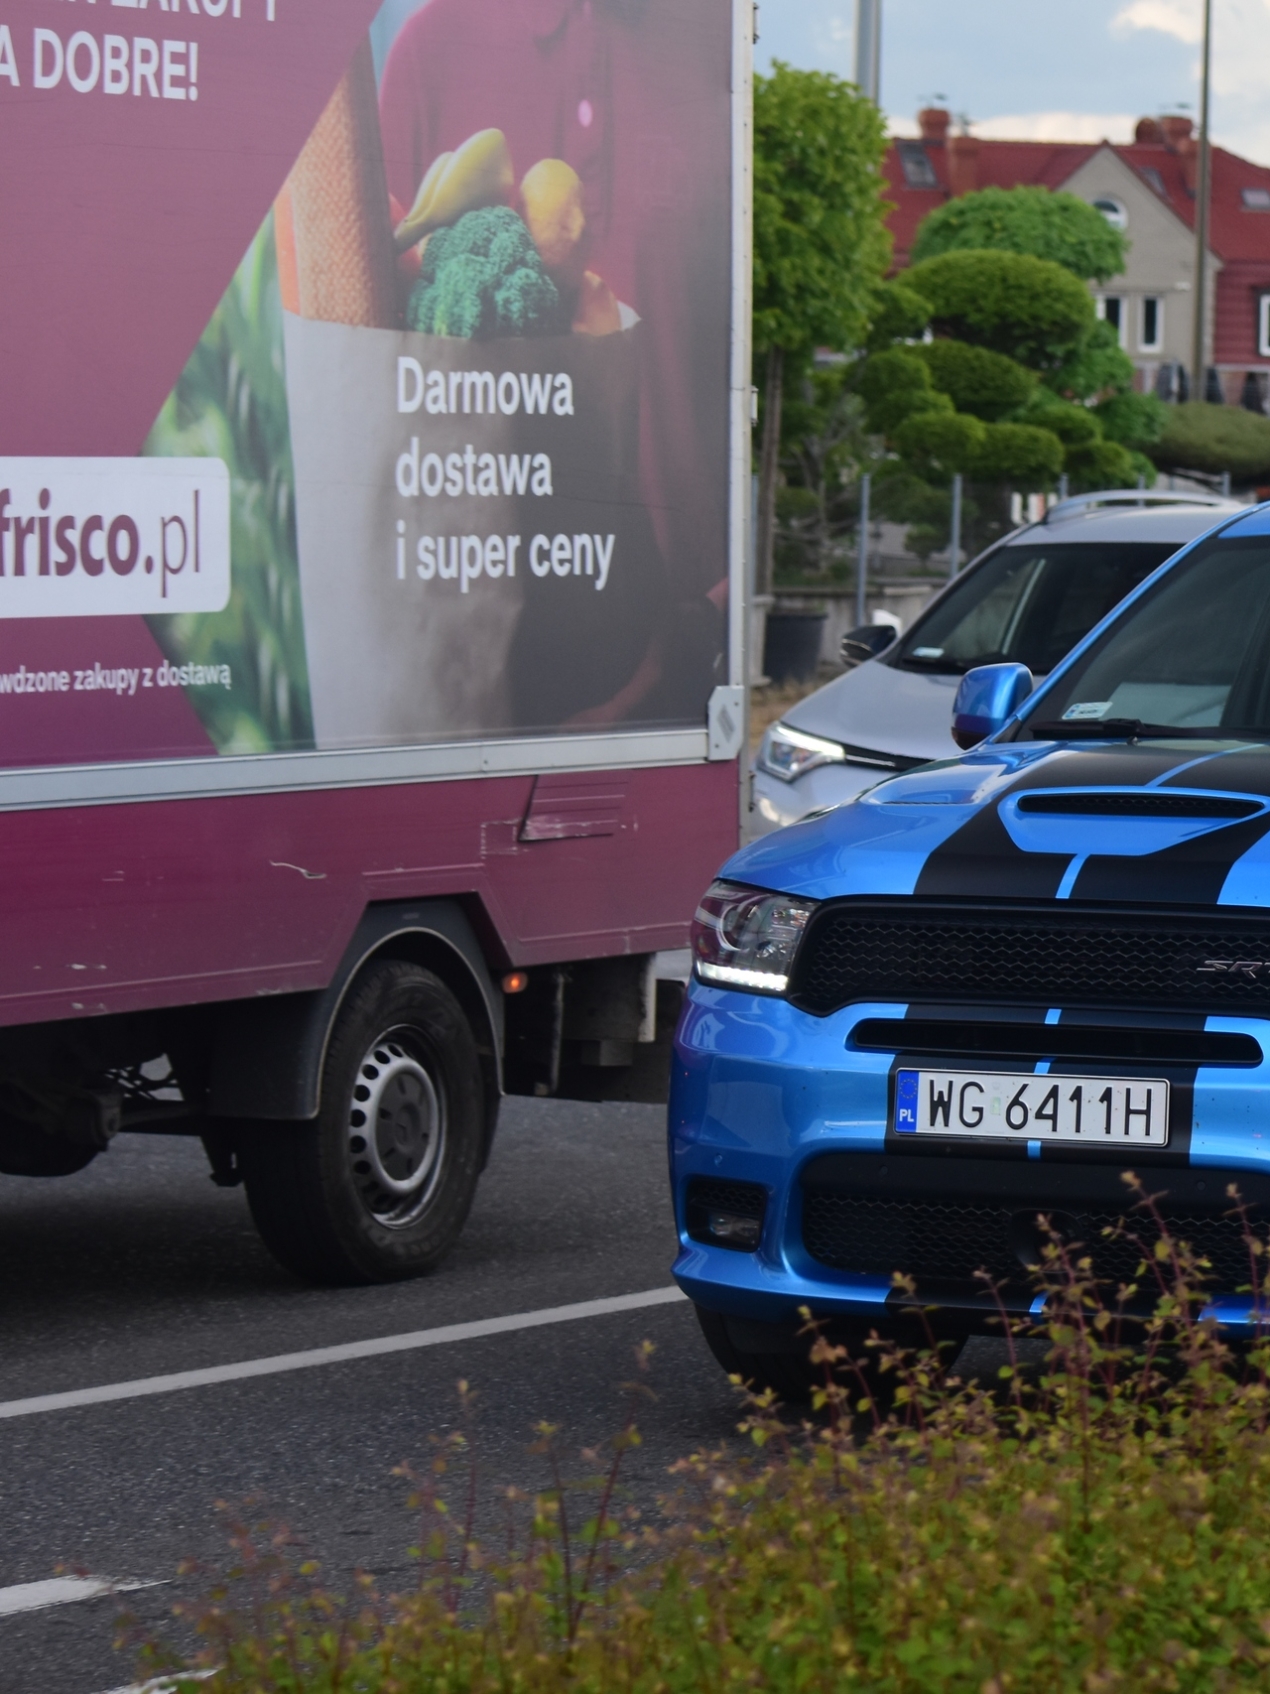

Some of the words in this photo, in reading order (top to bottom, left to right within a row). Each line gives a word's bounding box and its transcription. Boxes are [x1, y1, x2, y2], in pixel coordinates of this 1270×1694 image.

[33, 27, 199, 101] DOBRE!
[397, 356, 574, 416] Darmowa
[395, 436, 553, 497] dostawa
[0, 488, 200, 598] frisco.pl
[395, 519, 406, 580] i
[416, 534, 521, 594] super
[529, 533, 616, 591] ceny
[73, 661, 139, 695] zakupy
[142, 667, 153, 687] z
[156, 659, 231, 690] dostawą
[899, 1108, 914, 1122] PL
[929, 1079, 985, 1128] WG
[1005, 1083, 1152, 1136] 6411H
